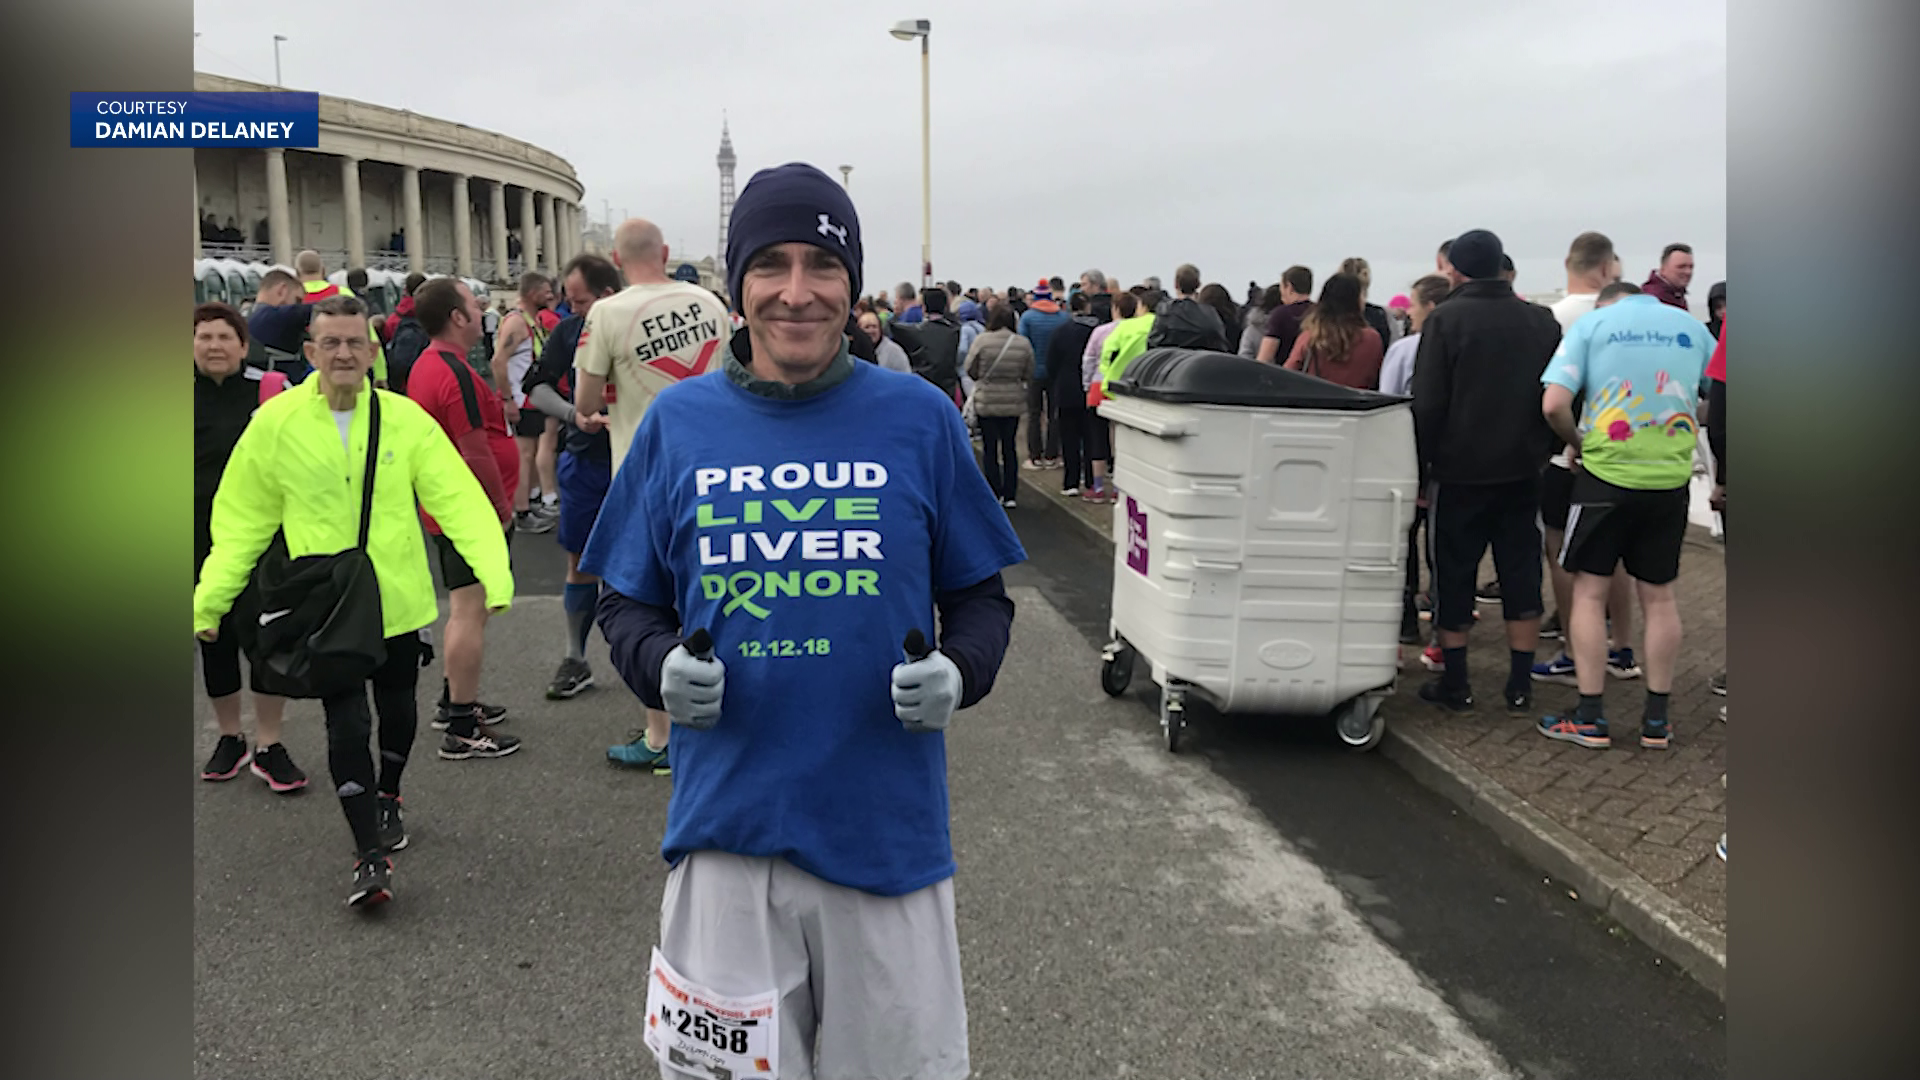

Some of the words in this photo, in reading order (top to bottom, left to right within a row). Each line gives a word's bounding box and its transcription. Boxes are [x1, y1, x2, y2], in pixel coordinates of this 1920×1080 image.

[642, 302, 702, 337] FCA-P
[1607, 330, 1643, 344] Alder
[1646, 330, 1673, 347] Hey
[695, 462, 888, 496] PROUD
[697, 498, 880, 527] LIVE
[698, 530, 884, 565] LIVER
[738, 638, 831, 657] 12.12.18
